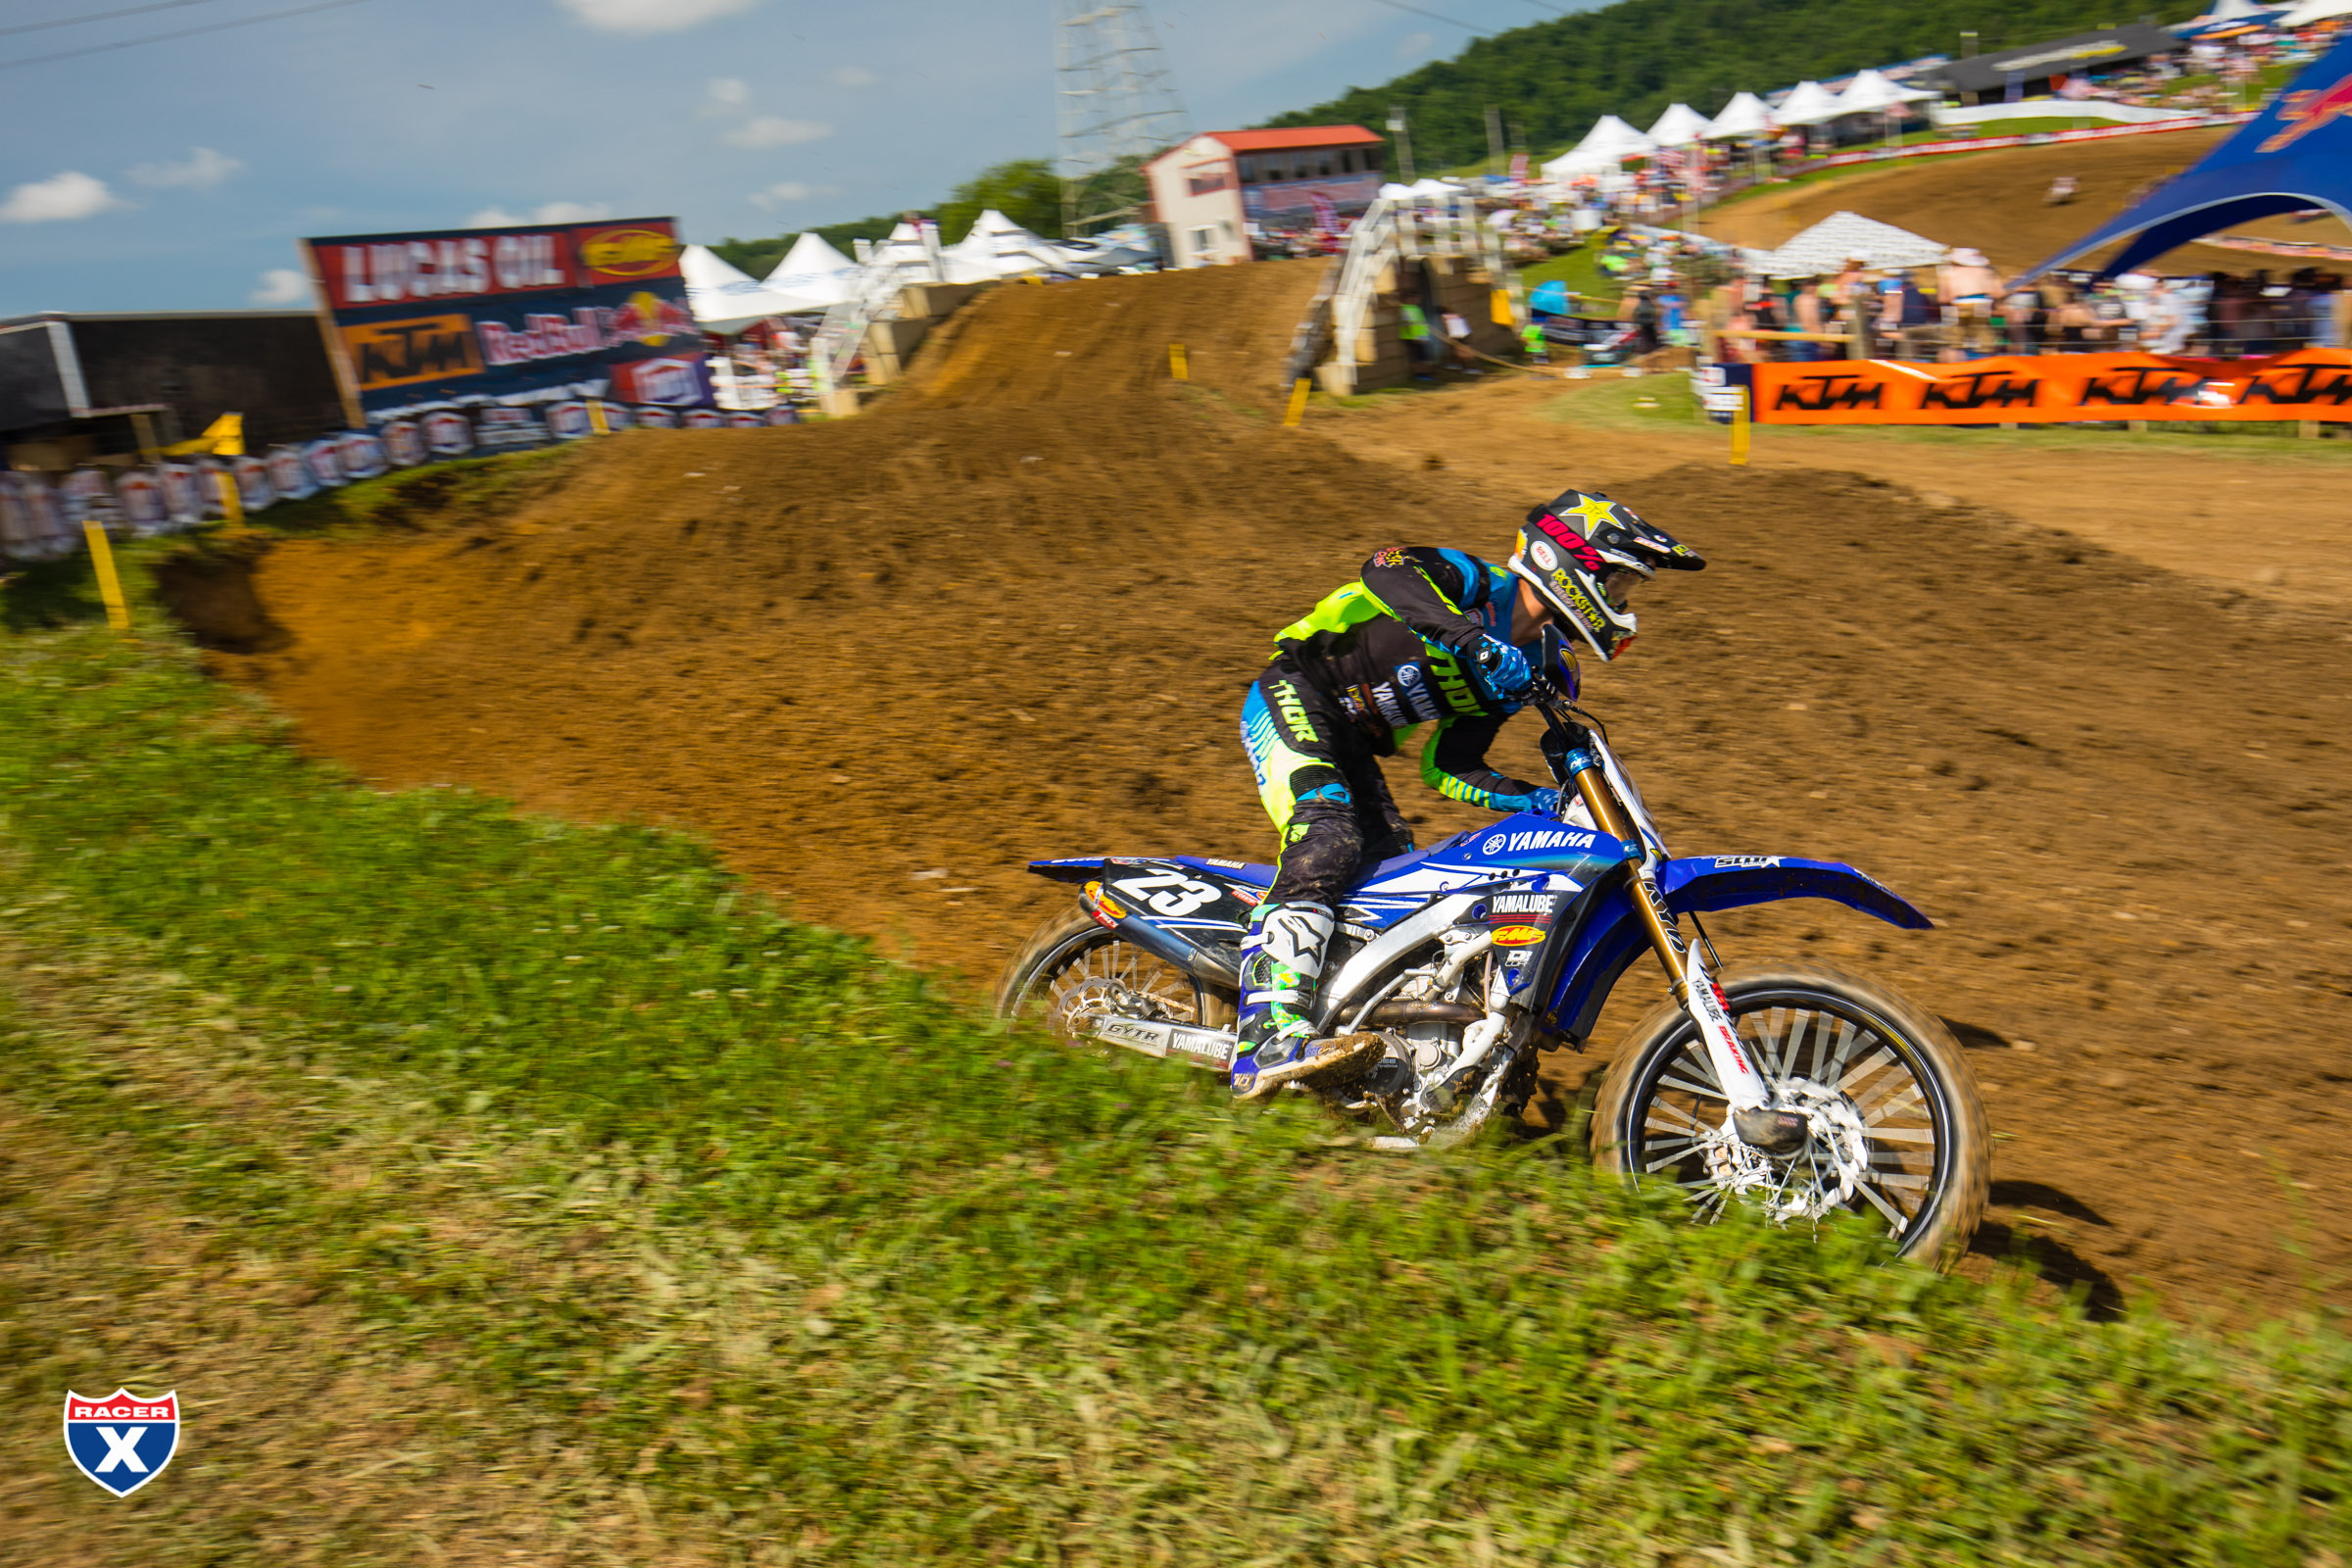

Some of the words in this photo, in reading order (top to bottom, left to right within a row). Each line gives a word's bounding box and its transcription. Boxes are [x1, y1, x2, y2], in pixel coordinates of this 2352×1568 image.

[342, 236, 489, 303] LUCAS
[492, 234, 565, 290] OIL
[361, 322, 469, 383] KTM
[1774, 373, 1885, 411] KTM
[1919, 370, 2040, 410] KTM
[2078, 366, 2215, 406] KTM
[1536, 514, 1607, 571] 100%
[1268, 679, 1319, 743] THOR
[1507, 830, 1596, 853] YAMAHA
[1205, 858, 1246, 870] YAMAHA
[1112, 868, 1222, 917] 23
[1492, 894, 1554, 914] YAMALUBE
[1493, 926, 1546, 943] FMF
[1642, 880, 1689, 954] KYB
[1691, 979, 1723, 1022] YAMALUBE
[1107, 1024, 1159, 1042] GYTR
[1172, 1032, 1231, 1060] YAMALUBE
[1718, 1025, 1749, 1075] BRAKING
